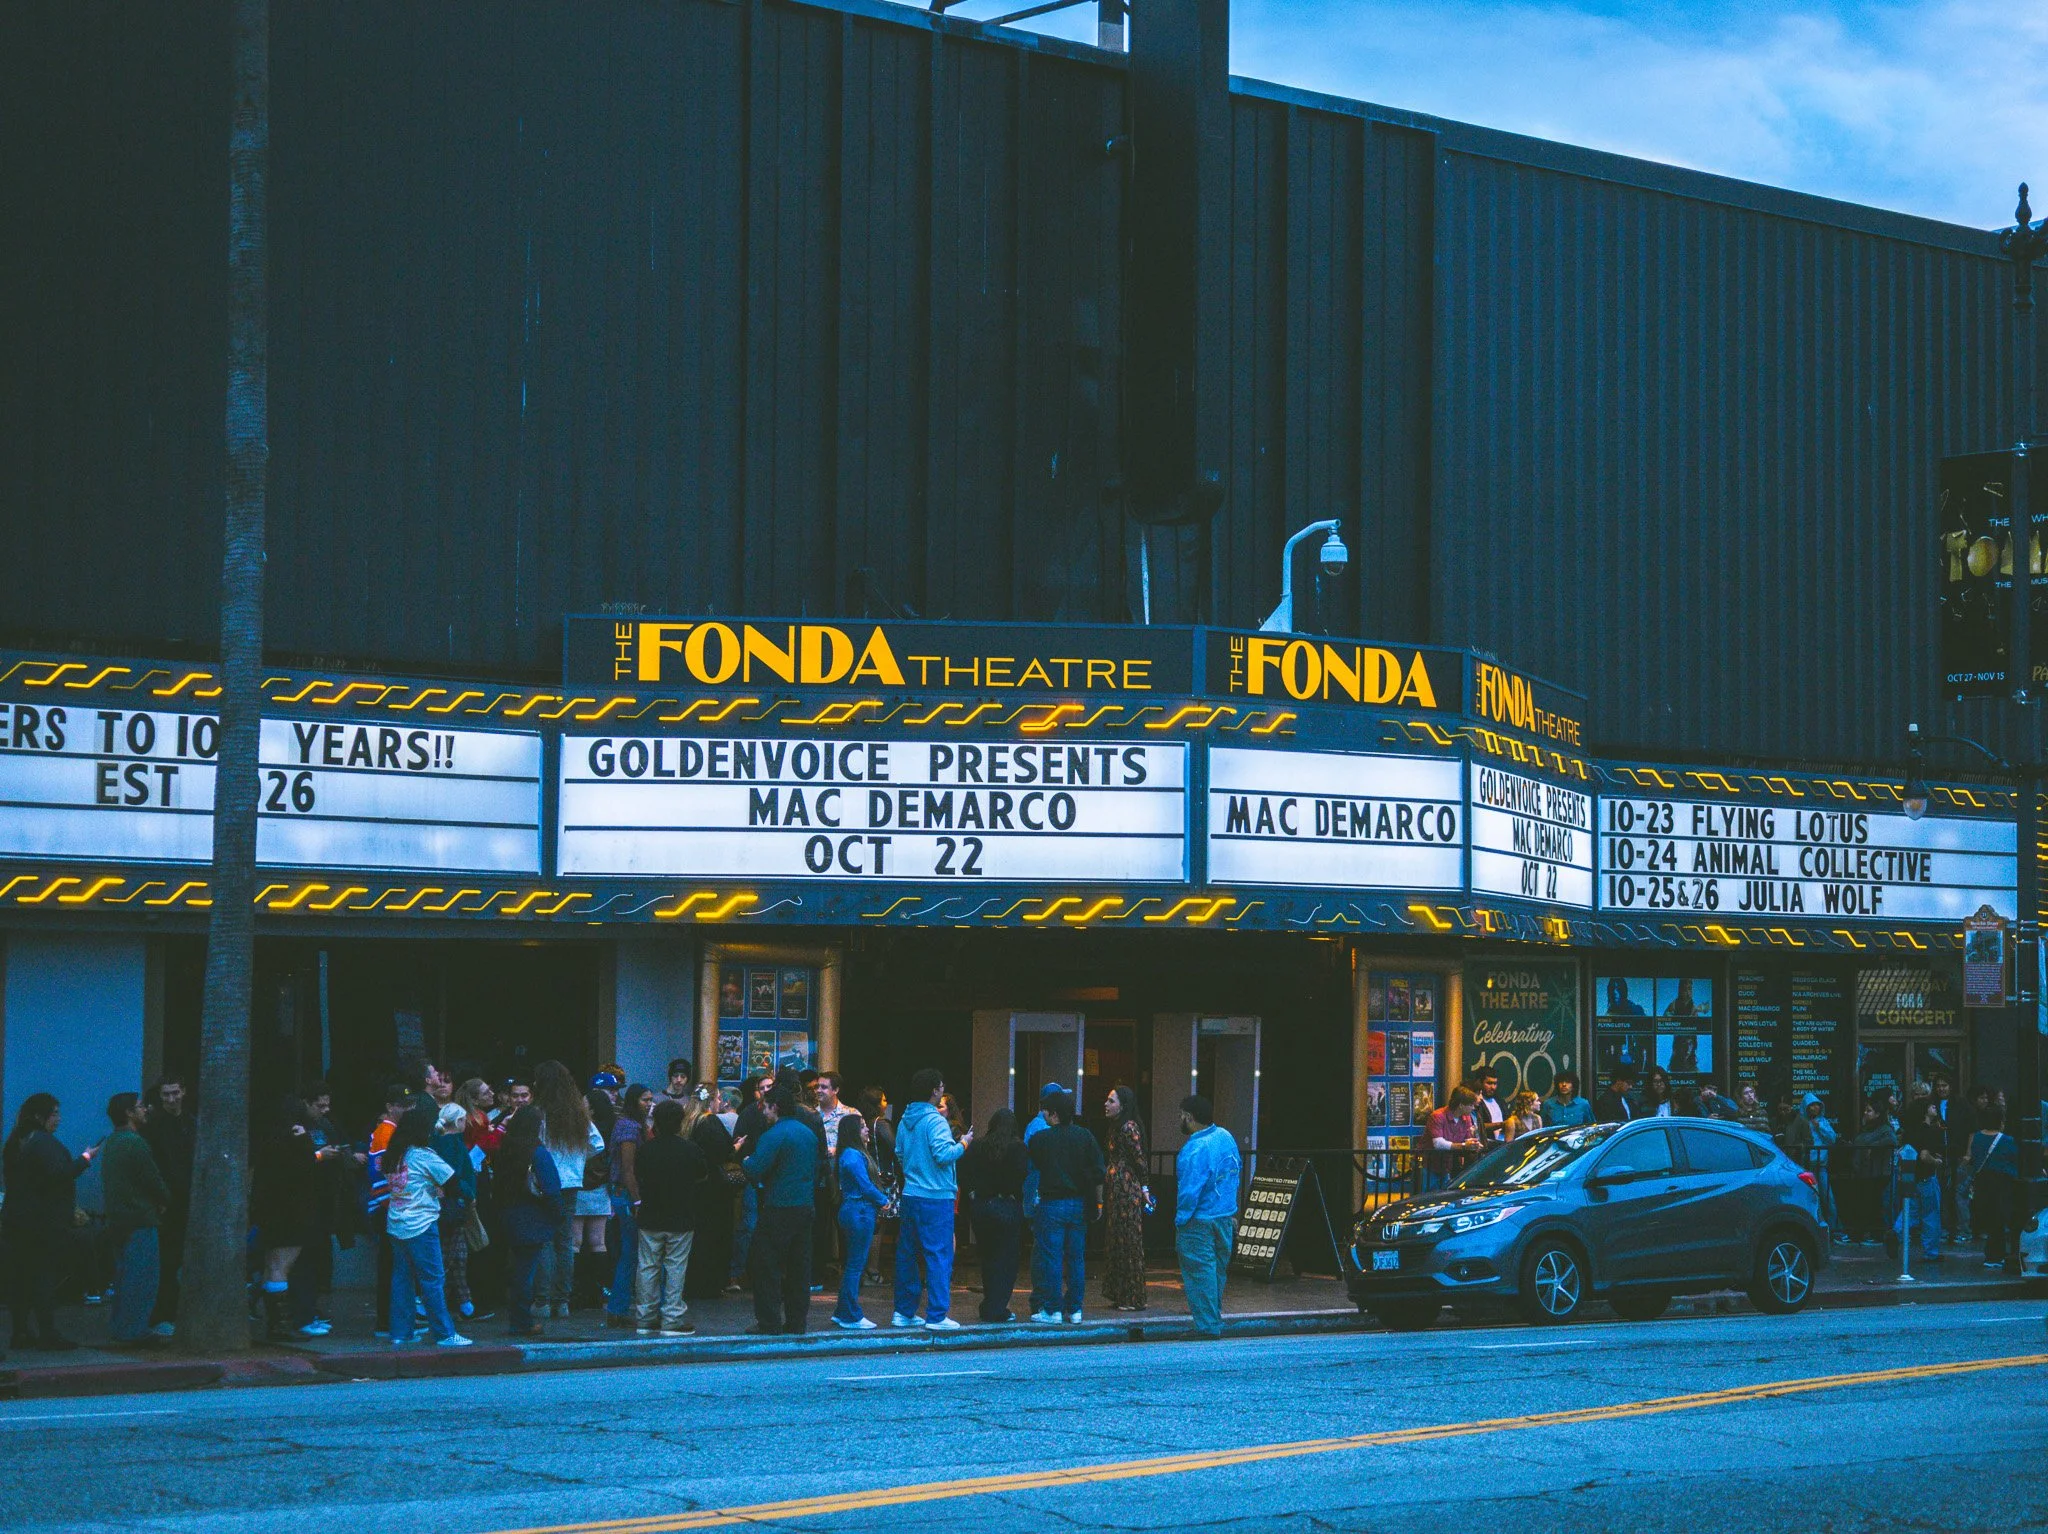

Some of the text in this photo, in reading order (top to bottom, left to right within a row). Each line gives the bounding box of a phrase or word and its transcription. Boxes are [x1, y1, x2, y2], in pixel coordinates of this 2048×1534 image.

[1988, 517, 2010, 527] THE
[614, 622, 1152, 690] THE FONDA THEATRE
[1229, 636, 1437, 708] THE FONDA
[1947, 671, 2005, 683] OCT 27 NOV 15
[1481, 662, 1536, 733] FONDA
[1534, 707, 1581, 747] THEATRE
[97, 711, 156, 756] TO
[292, 722, 456, 771] YEARS!!
[588, 738, 1147, 787] GOLDENVOICE PRESENTS
[97, 762, 316, 813] EST 26
[748, 787, 1077, 831] MAC DEMARCO
[1479, 767, 1586, 828] GOLDENVOICE PRESENTS
[1225, 795, 1456, 843] MAC DEMARCO
[1512, 816, 1574, 863] MAC DEMARCO
[1609, 800, 1868, 844] 10-23 FLYING LOTUS
[804, 834, 983, 876] OCT 22
[1609, 838, 1931, 883] 10-24 ANIMAL COLLECTIVE
[1521, 860, 1557, 899] OCT 22
[1738, 880, 1805, 913] JULIA
[1823, 883, 1883, 915] WOLF
[1479, 991, 1549, 1009] THEATRE
[1875, 1009, 1955, 1025] CONCERT
[1896, 991, 1924, 1008] FOR A
[1473, 1019, 1555, 1053] Celebrating
[1253, 1176, 1283, 1184] PROHIBITED
